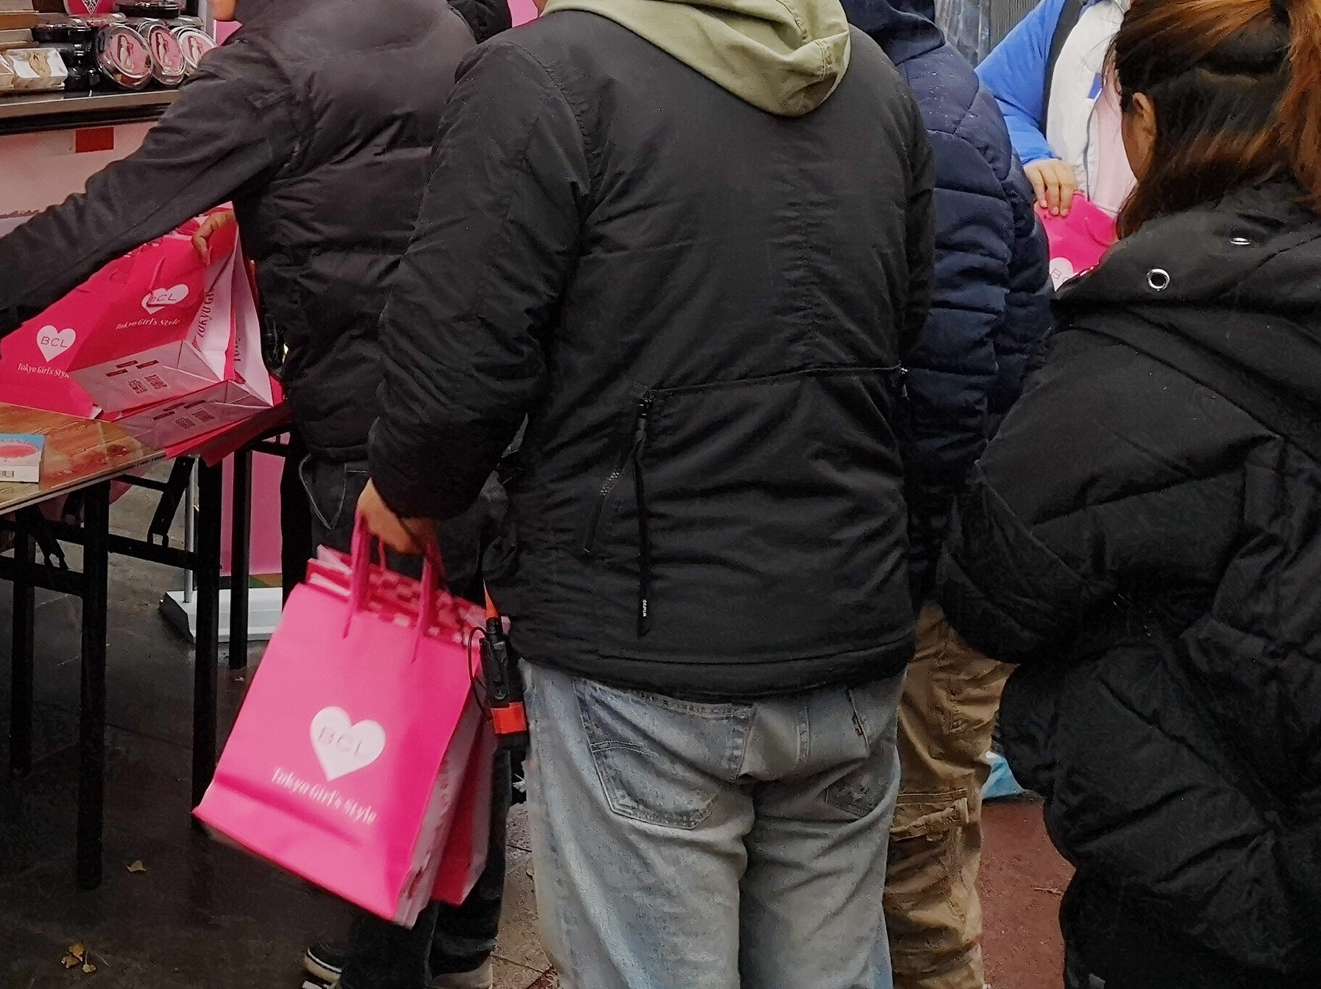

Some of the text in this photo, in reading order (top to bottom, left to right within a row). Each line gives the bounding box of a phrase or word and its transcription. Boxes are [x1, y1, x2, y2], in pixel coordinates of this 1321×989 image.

[40, 336, 67, 348] BCL
[317, 725, 371, 760] BCL
[271, 767, 310, 795] Tokyo
